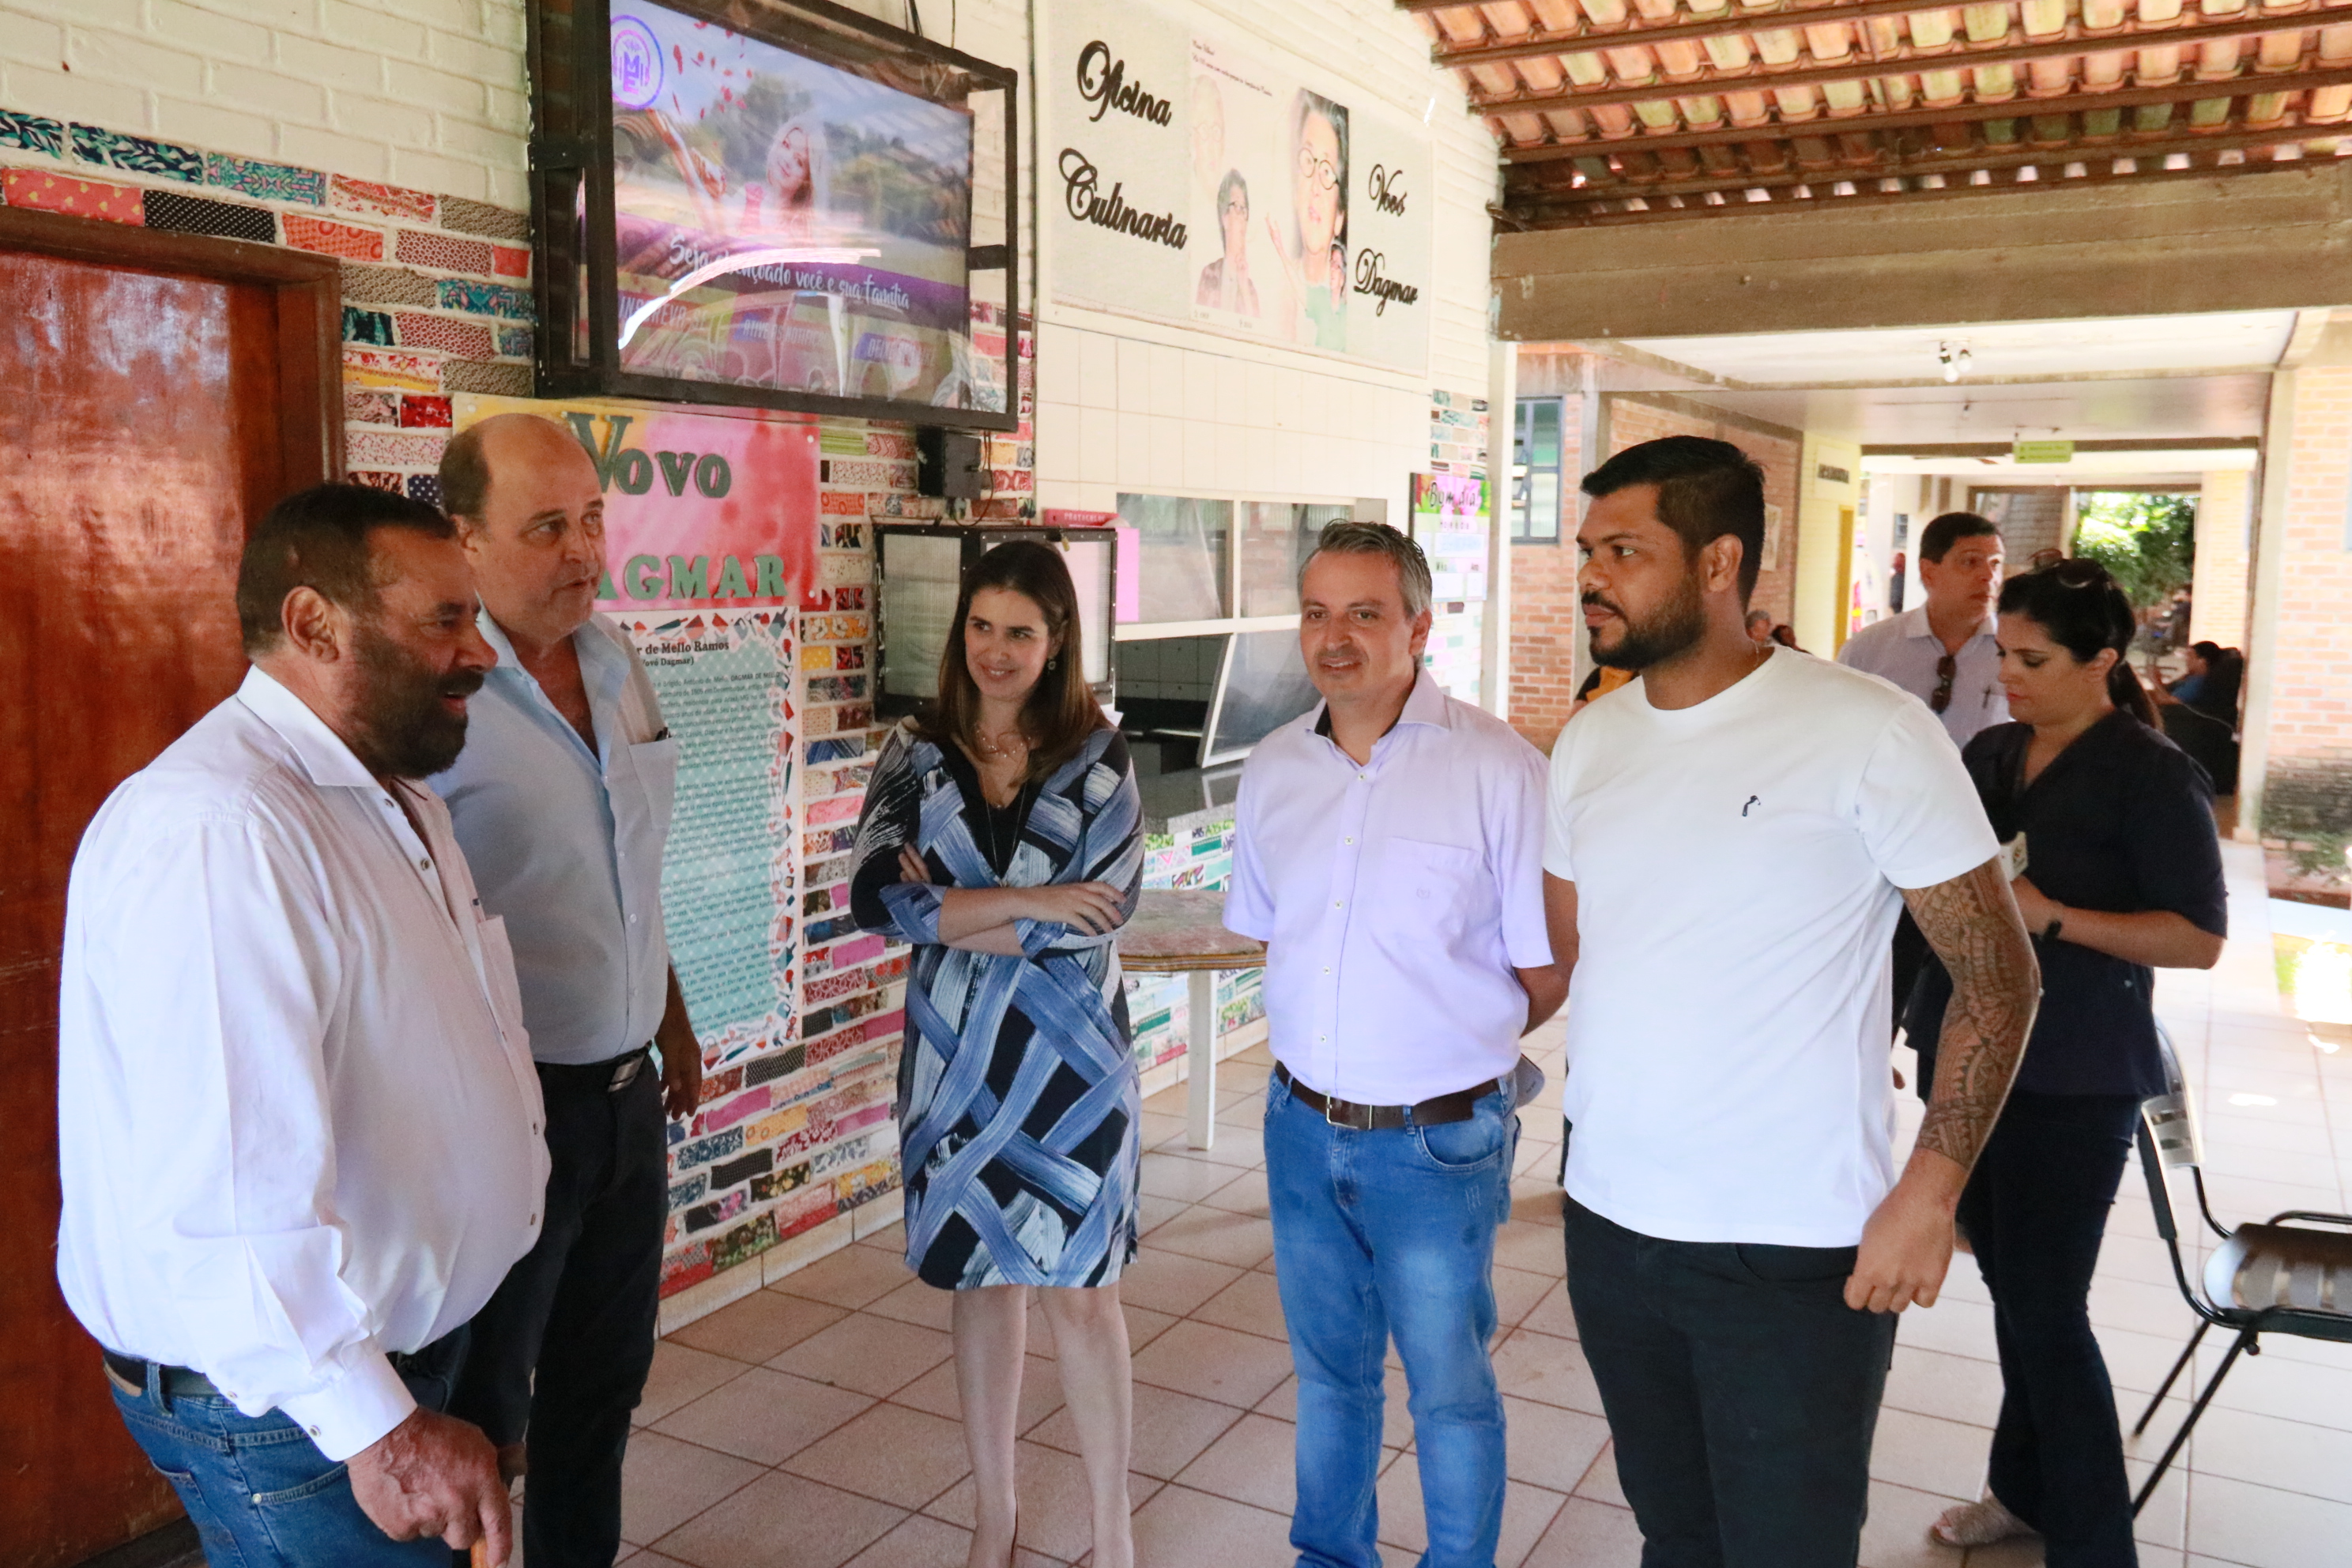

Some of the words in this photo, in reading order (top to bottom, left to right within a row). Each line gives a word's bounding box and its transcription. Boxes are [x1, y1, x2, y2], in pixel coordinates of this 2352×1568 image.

[1077, 40, 1171, 127] Oficina
[669, 234, 709, 271] Seja
[795, 270, 824, 290] você
[827, 277, 834, 291] e
[838, 281, 862, 298] sua
[863, 273, 910, 311] família
[1353, 249, 1419, 317] Dagmar
[1430, 481, 1454, 508] Bom
[1458, 483, 1481, 509] dia!
[594, 555, 788, 601] GMAR
[643, 658, 659, 667] ovó
[661, 657, 695, 667] Dagmar)
[645, 644, 659, 654] de
[662, 642, 692, 654] Mello
[694, 640, 729, 652] Ramos
